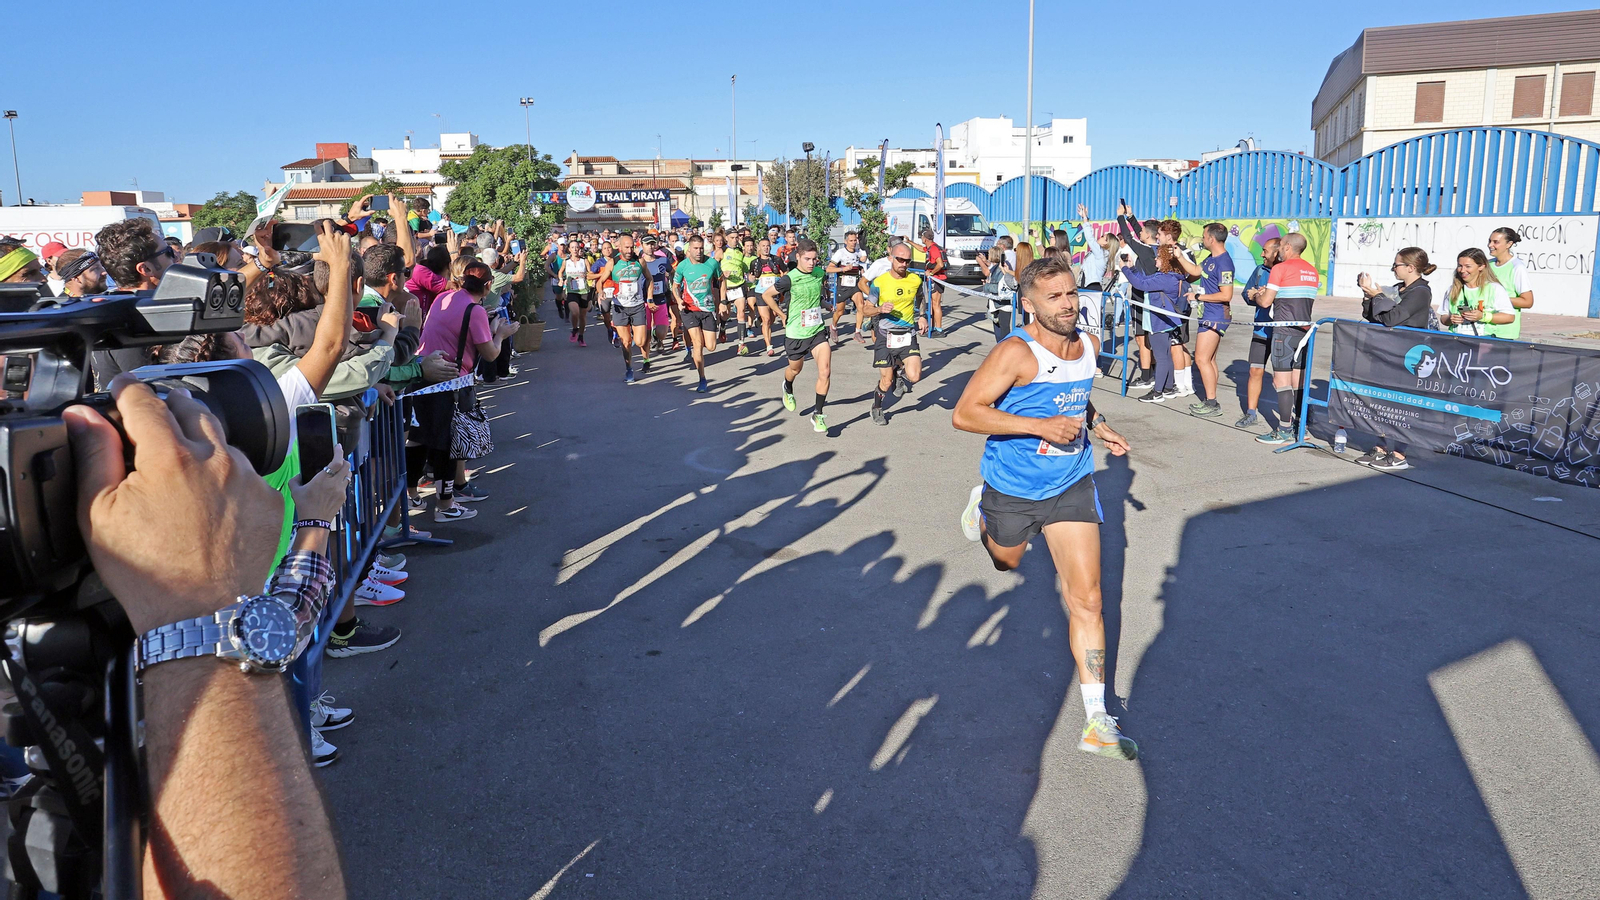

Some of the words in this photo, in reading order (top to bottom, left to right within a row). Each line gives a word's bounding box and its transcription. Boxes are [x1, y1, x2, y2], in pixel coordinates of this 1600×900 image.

[600, 192, 630, 201] TRAIL
[631, 191, 666, 201] PIRATA
[0, 231, 95, 248] COSUR
[1517, 217, 1584, 245] ACCIÓN
[1082, 326, 1100, 335] PIRATA
[1437, 349, 1513, 388] NEKO
[1416, 378, 1497, 402] PUBLICIDAD
[1369, 402, 1420, 418] MERCHANDISING
[330, 638, 349, 647] HOKA
[20, 677, 102, 806] Panasonic
